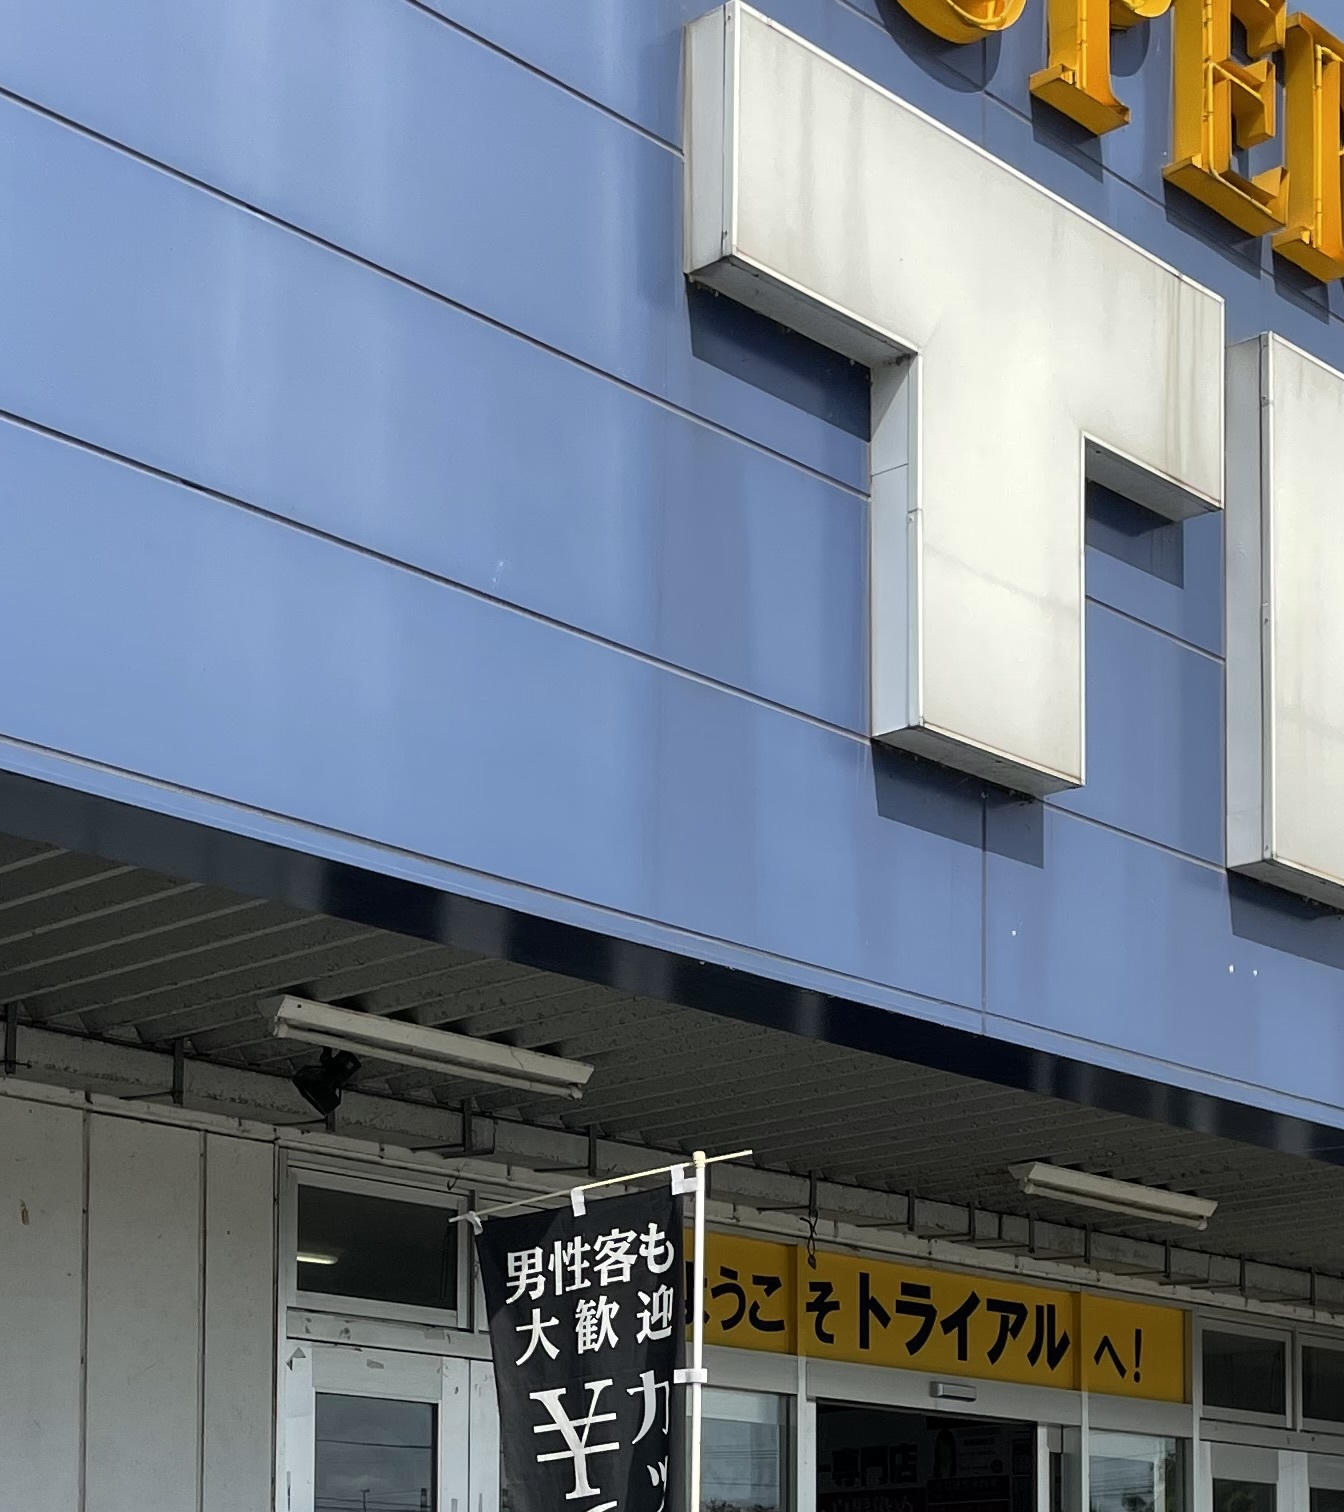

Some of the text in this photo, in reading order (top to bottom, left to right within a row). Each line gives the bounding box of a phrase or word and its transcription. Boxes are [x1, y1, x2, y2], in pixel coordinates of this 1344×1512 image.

[506, 1222, 674, 1305] 男性客も
[515, 1284, 674, 1367] 大歓迎
